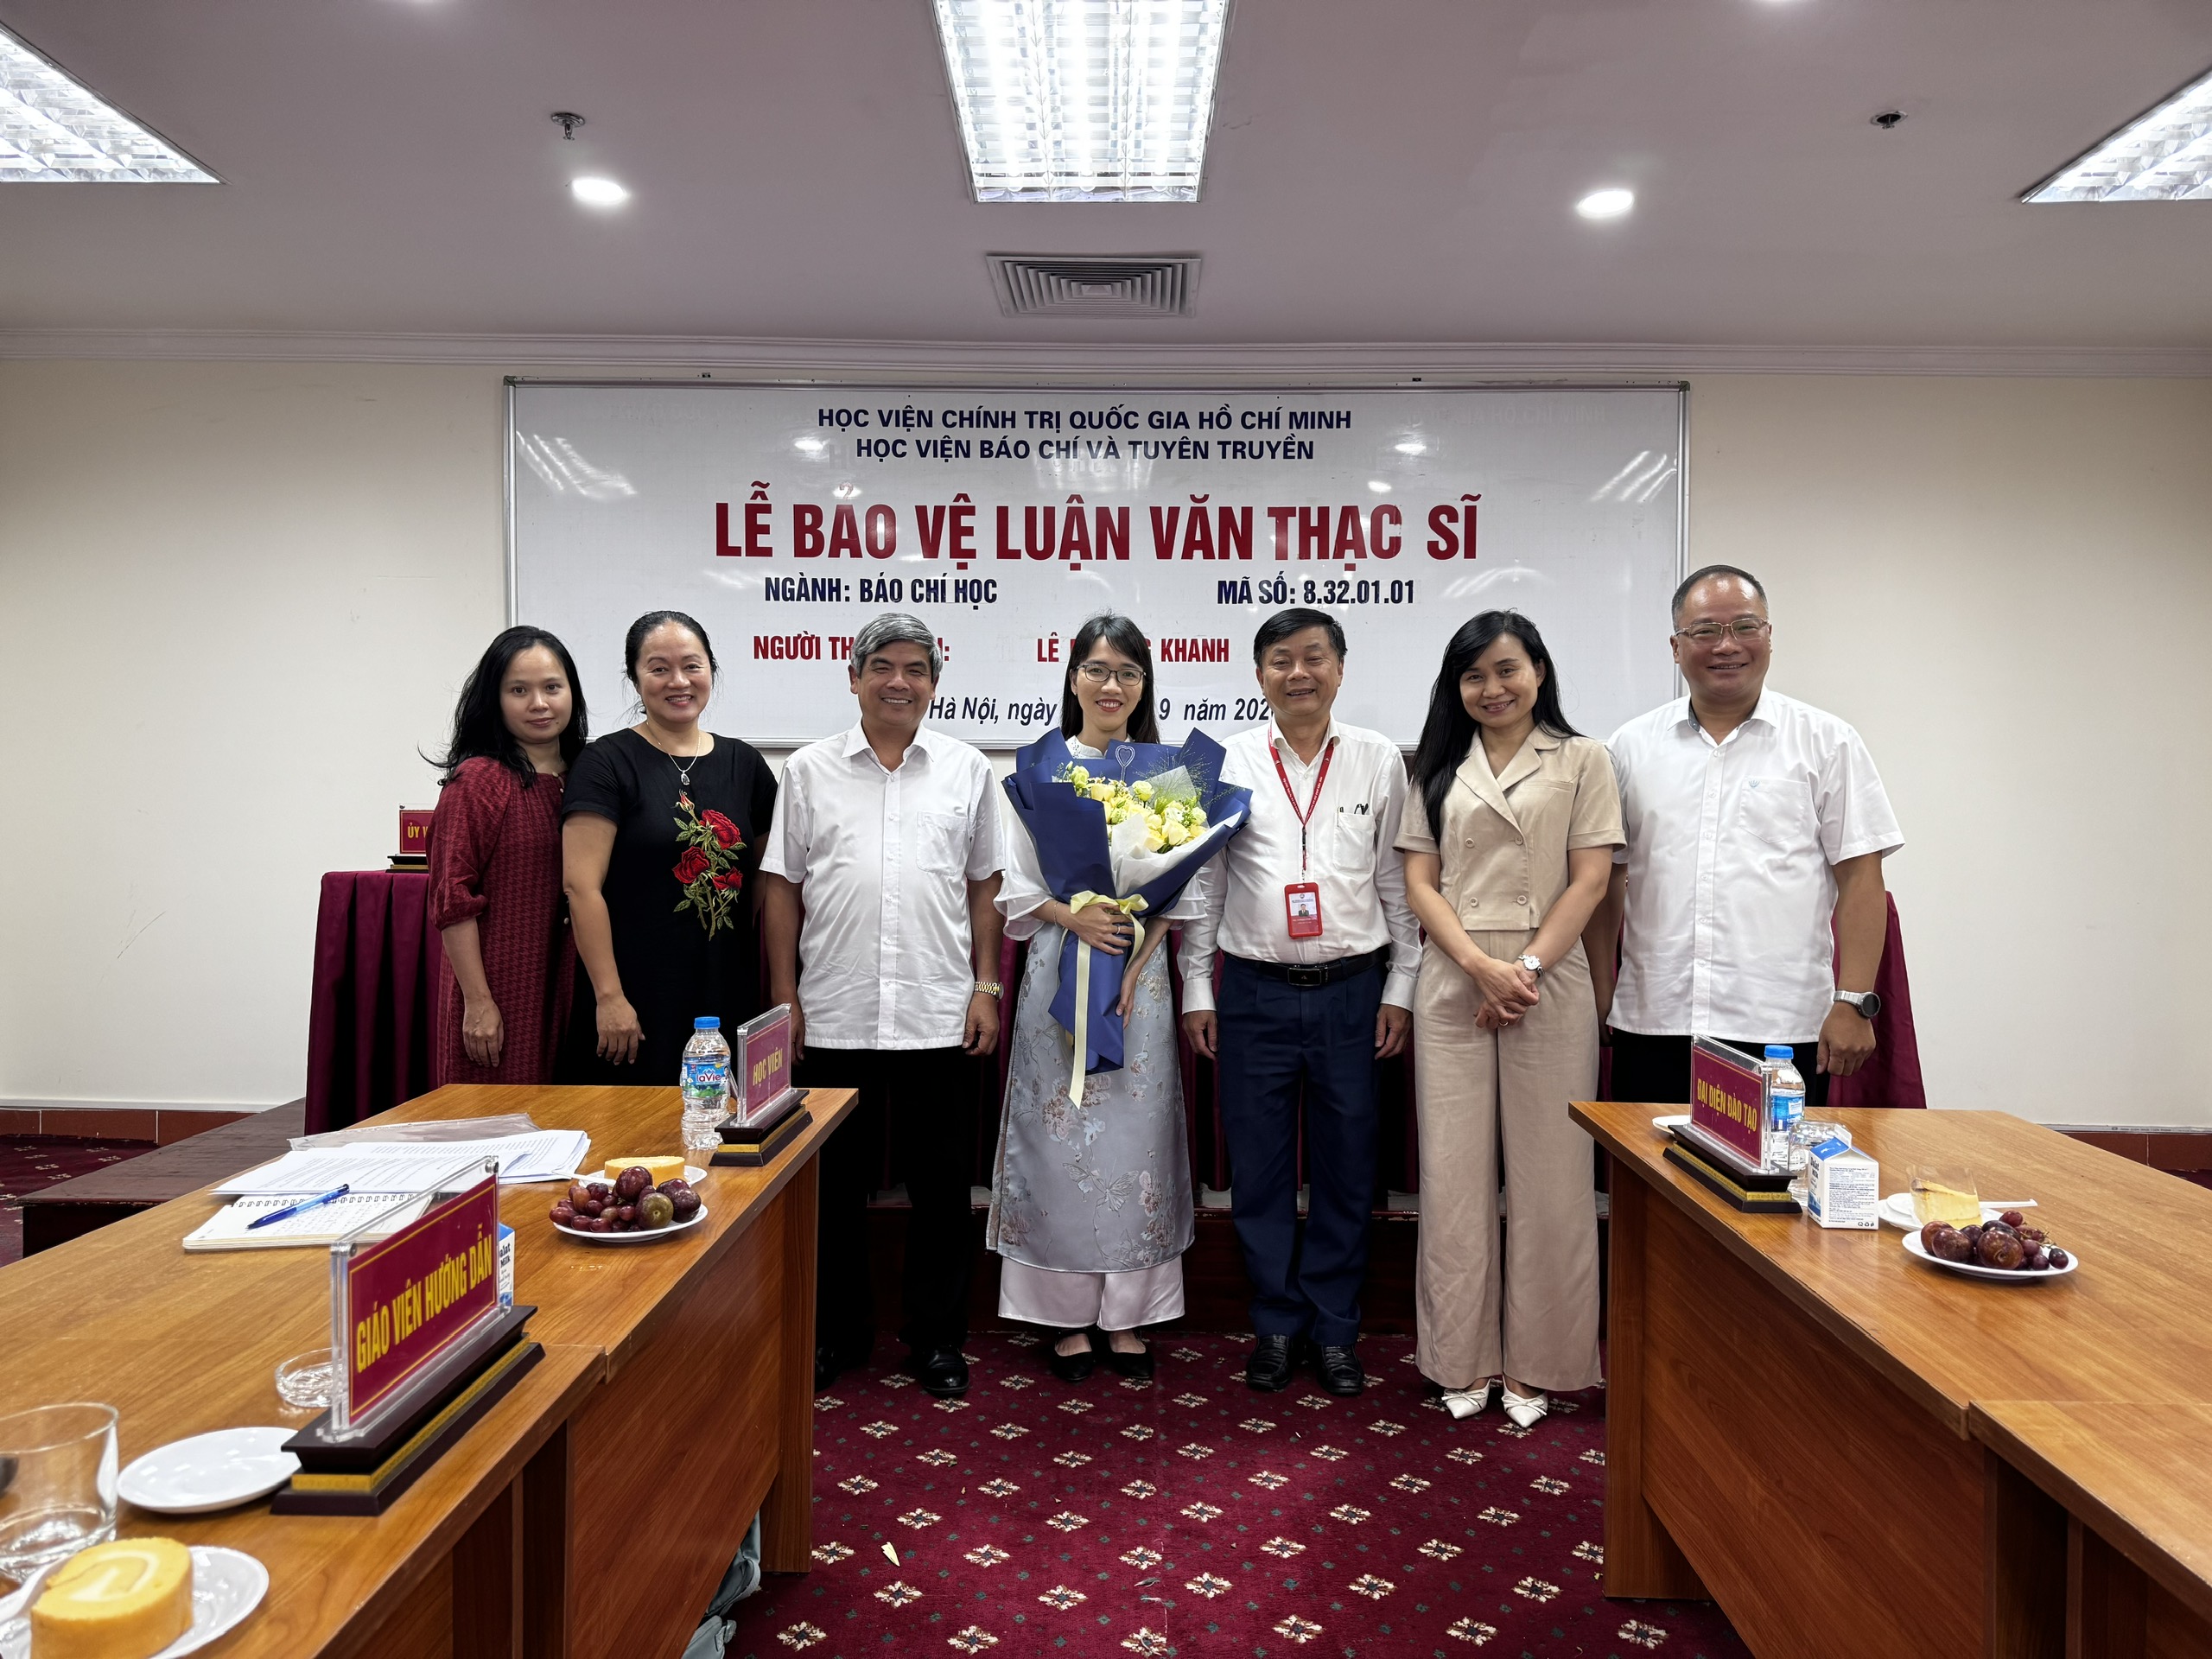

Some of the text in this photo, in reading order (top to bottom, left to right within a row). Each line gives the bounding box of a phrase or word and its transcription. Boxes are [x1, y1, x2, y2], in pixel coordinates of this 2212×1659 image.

[819, 404, 1351, 433] HỌC VIỆN CHÍNH TRỊ QUỐC GIA HỒ CHÍ MINH
[857, 433, 1313, 462] HỌC VIỆN BÁO CHÍ VÀ TUYÊN TRUYỀN
[716, 481, 1481, 571] LỄ BẢO VỆ LUẬN VĂN THẠC SĨ
[766, 572, 996, 610] NGÀNH: BÁO CHÍ HỌC
[1217, 571, 1413, 604] MÃ SỐ: 8.32.01.01
[754, 631, 854, 660] NGƯỜI TH
[1038, 632, 1058, 662] LÊ
[1161, 639, 1229, 662] KHANH
[929, 694, 1273, 726] Hà Nội, ngày 9 năm 202
[408, 822, 420, 838] ỦY
[753, 1046, 783, 1088] HỌC VIÊN
[1697, 1077, 1758, 1135] ĐẠI DIỆN ĐÀO TẠO
[356, 1224, 493, 1373] GIÁO VIÊN HƯỚNG DẪN
